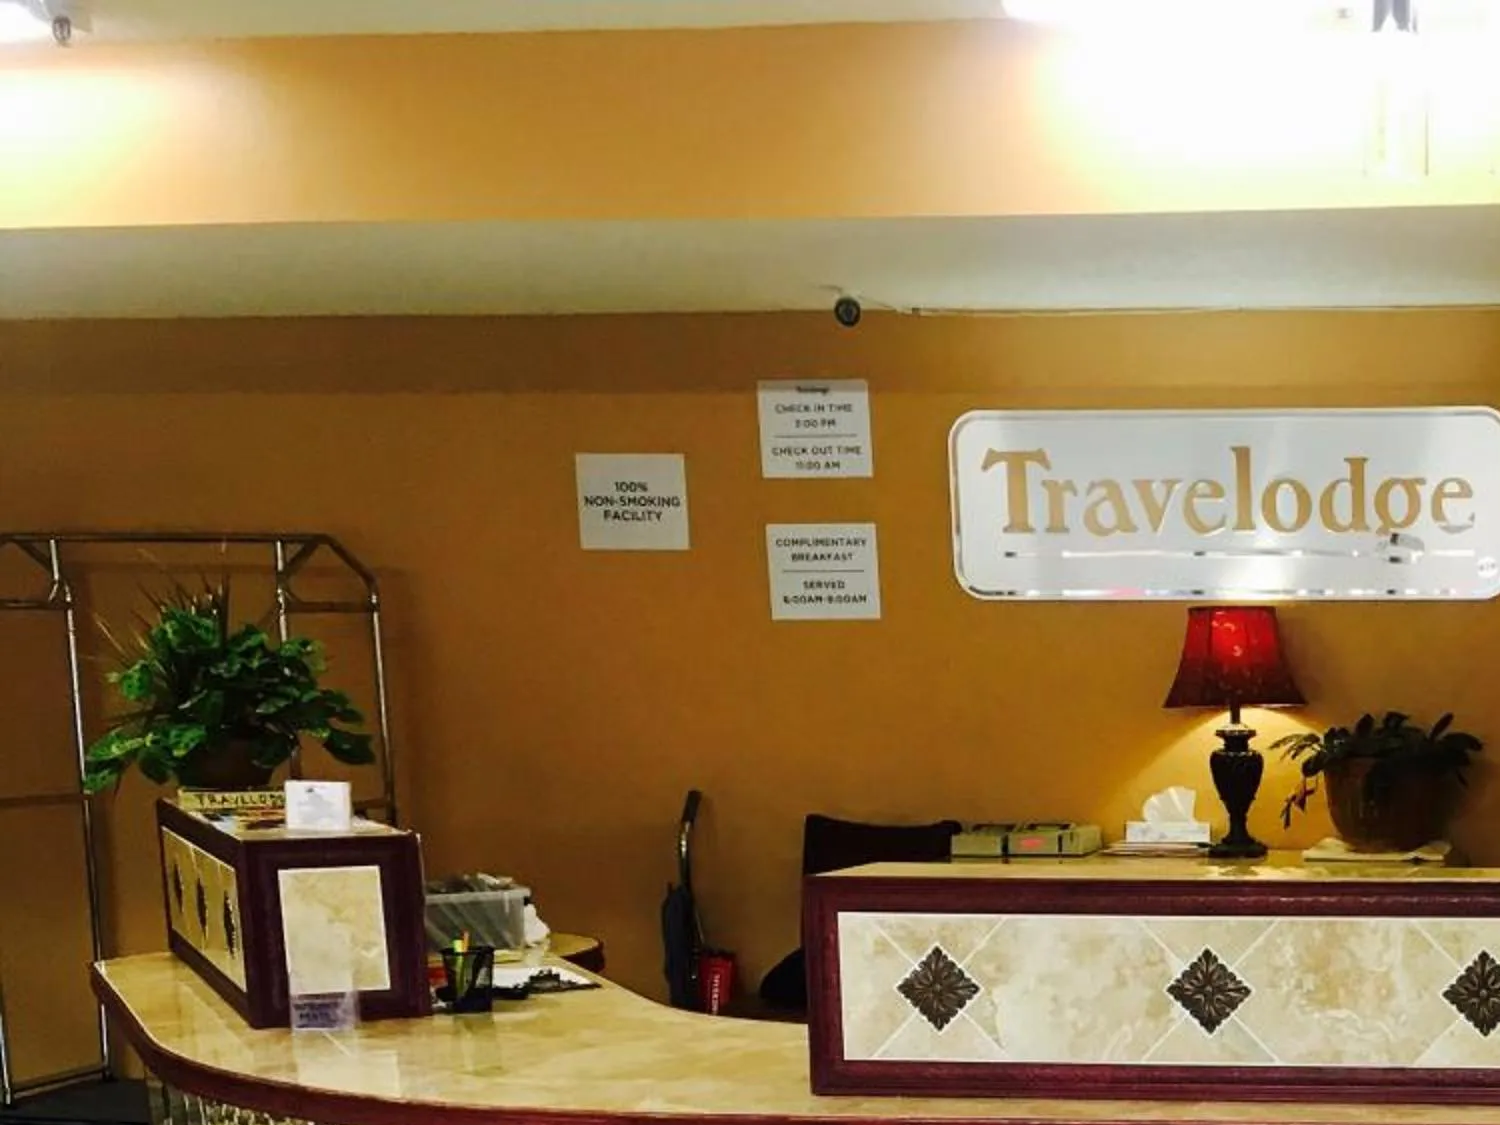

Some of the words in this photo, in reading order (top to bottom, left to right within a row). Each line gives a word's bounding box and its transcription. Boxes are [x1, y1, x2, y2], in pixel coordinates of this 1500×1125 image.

[774, 403, 810, 414] CHECK
[826, 403, 853, 412] TIME
[771, 447, 808, 457] CHECK
[811, 446, 833, 456] OUT
[824, 461, 841, 470] AM
[614, 481, 649, 492] 100%
[584, 495, 681, 507] NON-SMOKING
[981, 445, 1476, 562] Travelodge
[603, 509, 663, 521] FACILITY
[775, 537, 867, 547] COMPLIMENTARY
[791, 552, 853, 562] BREAKFAST
[803, 580, 846, 589] SERVED
